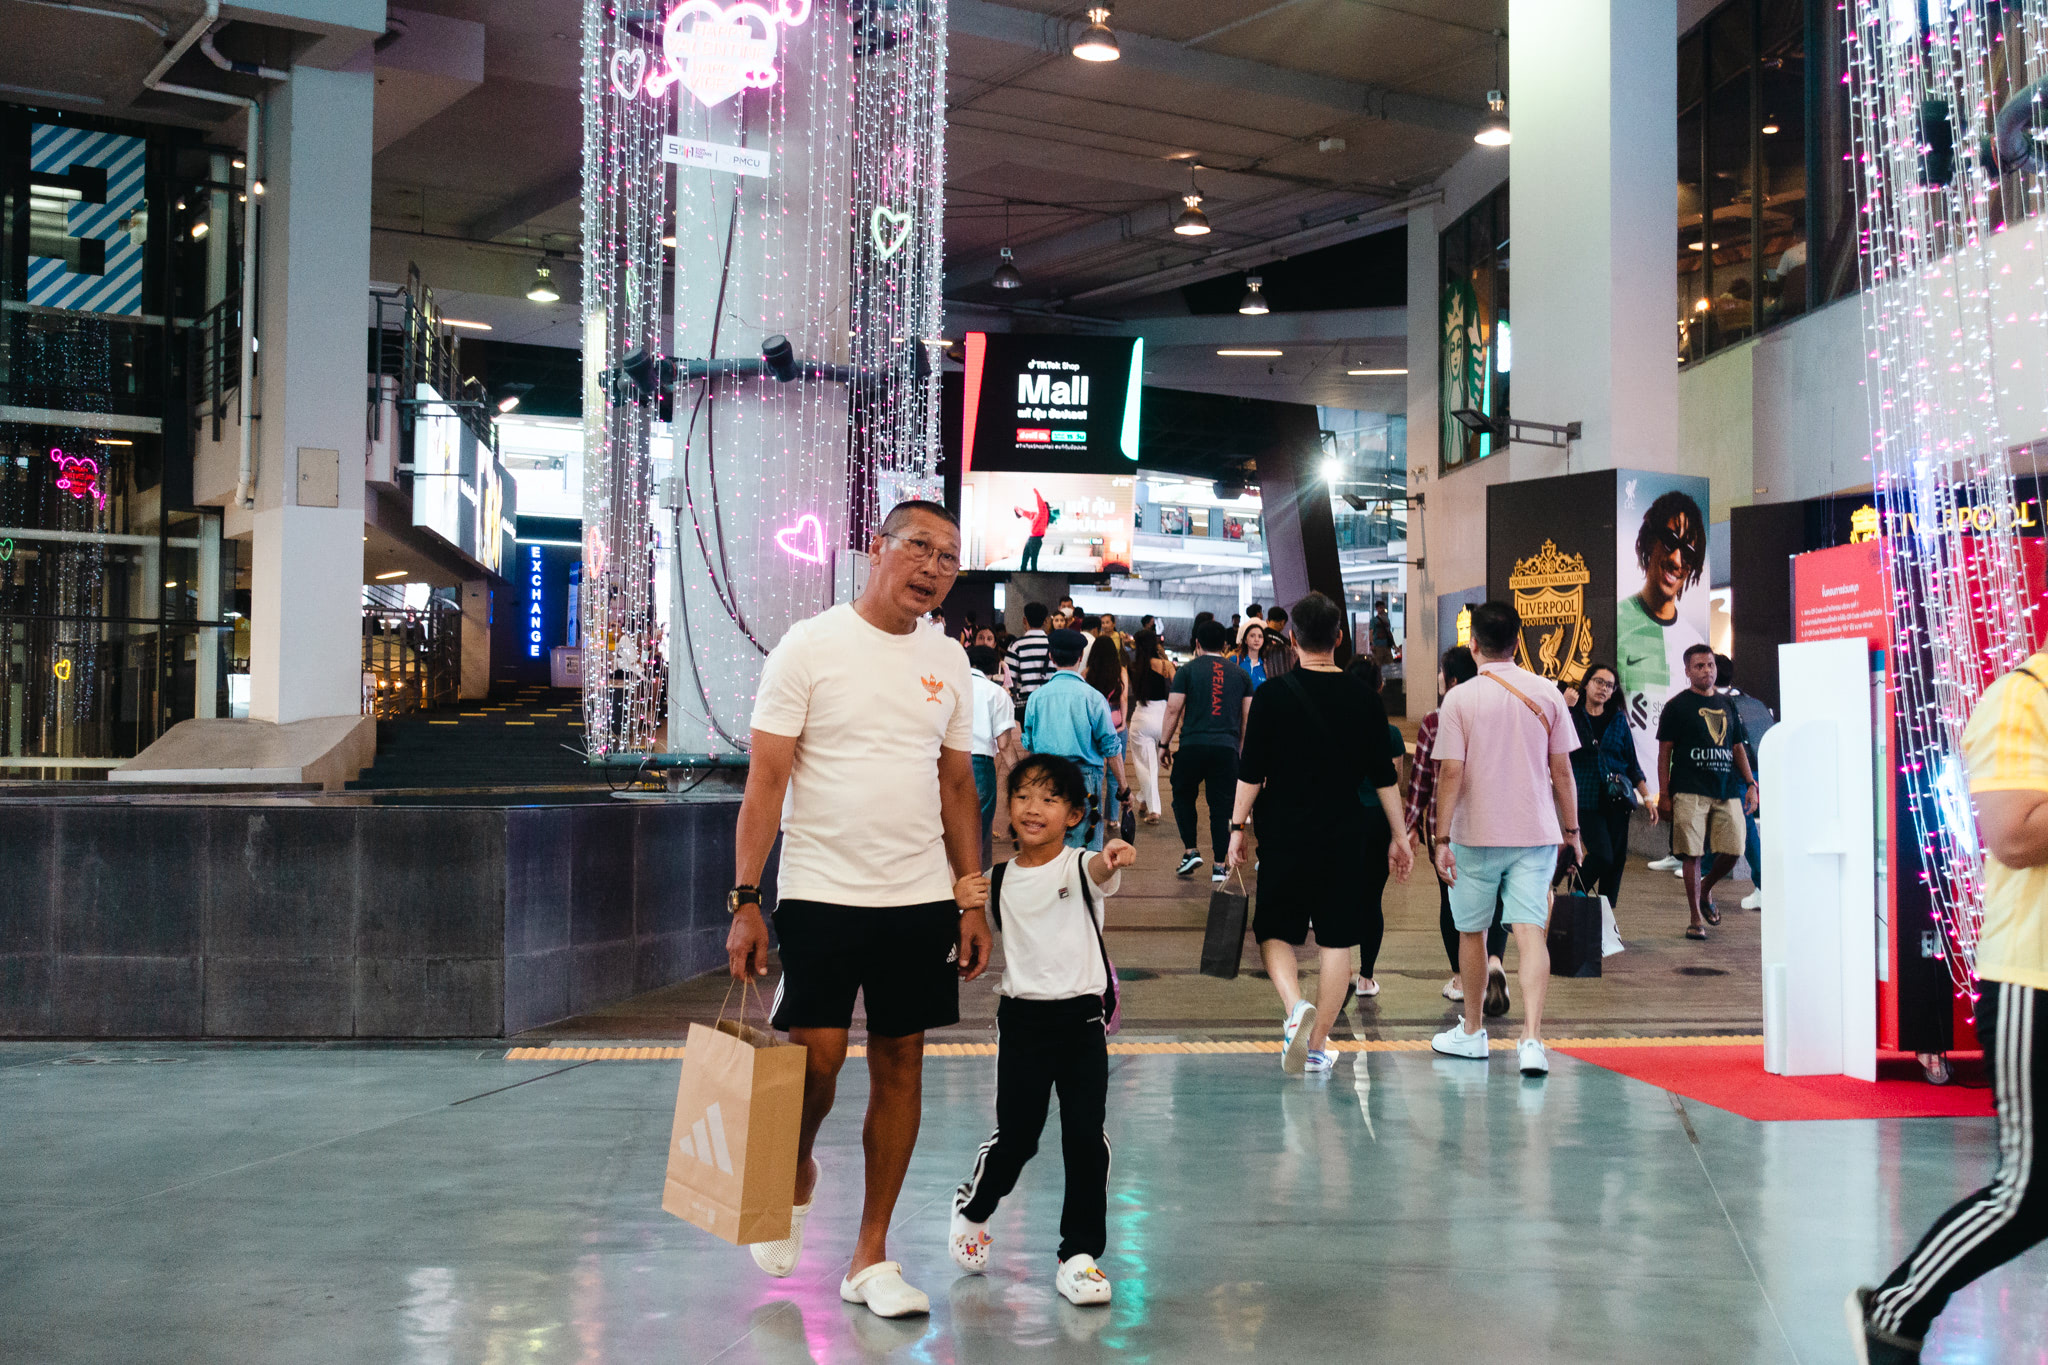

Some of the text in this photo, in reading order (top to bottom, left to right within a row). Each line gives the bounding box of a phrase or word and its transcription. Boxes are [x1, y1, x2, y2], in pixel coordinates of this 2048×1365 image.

[733, 156, 761, 168] PMCU
[1036, 360, 1080, 372] TikTok Shop
[1018, 373, 1089, 405] Mall
[1530, 576, 1548, 586] NEVER
[1549, 575, 1566, 584] WALK
[1566, 573, 1587, 582] ALONE
[530, 546, 542, 657] EXCHANGE
[1520, 599, 1577, 616] LIVERPOOL
[1521, 615, 1576, 627] FOOTBALL CLUB
[1211, 660, 1224, 716] APEMAN
